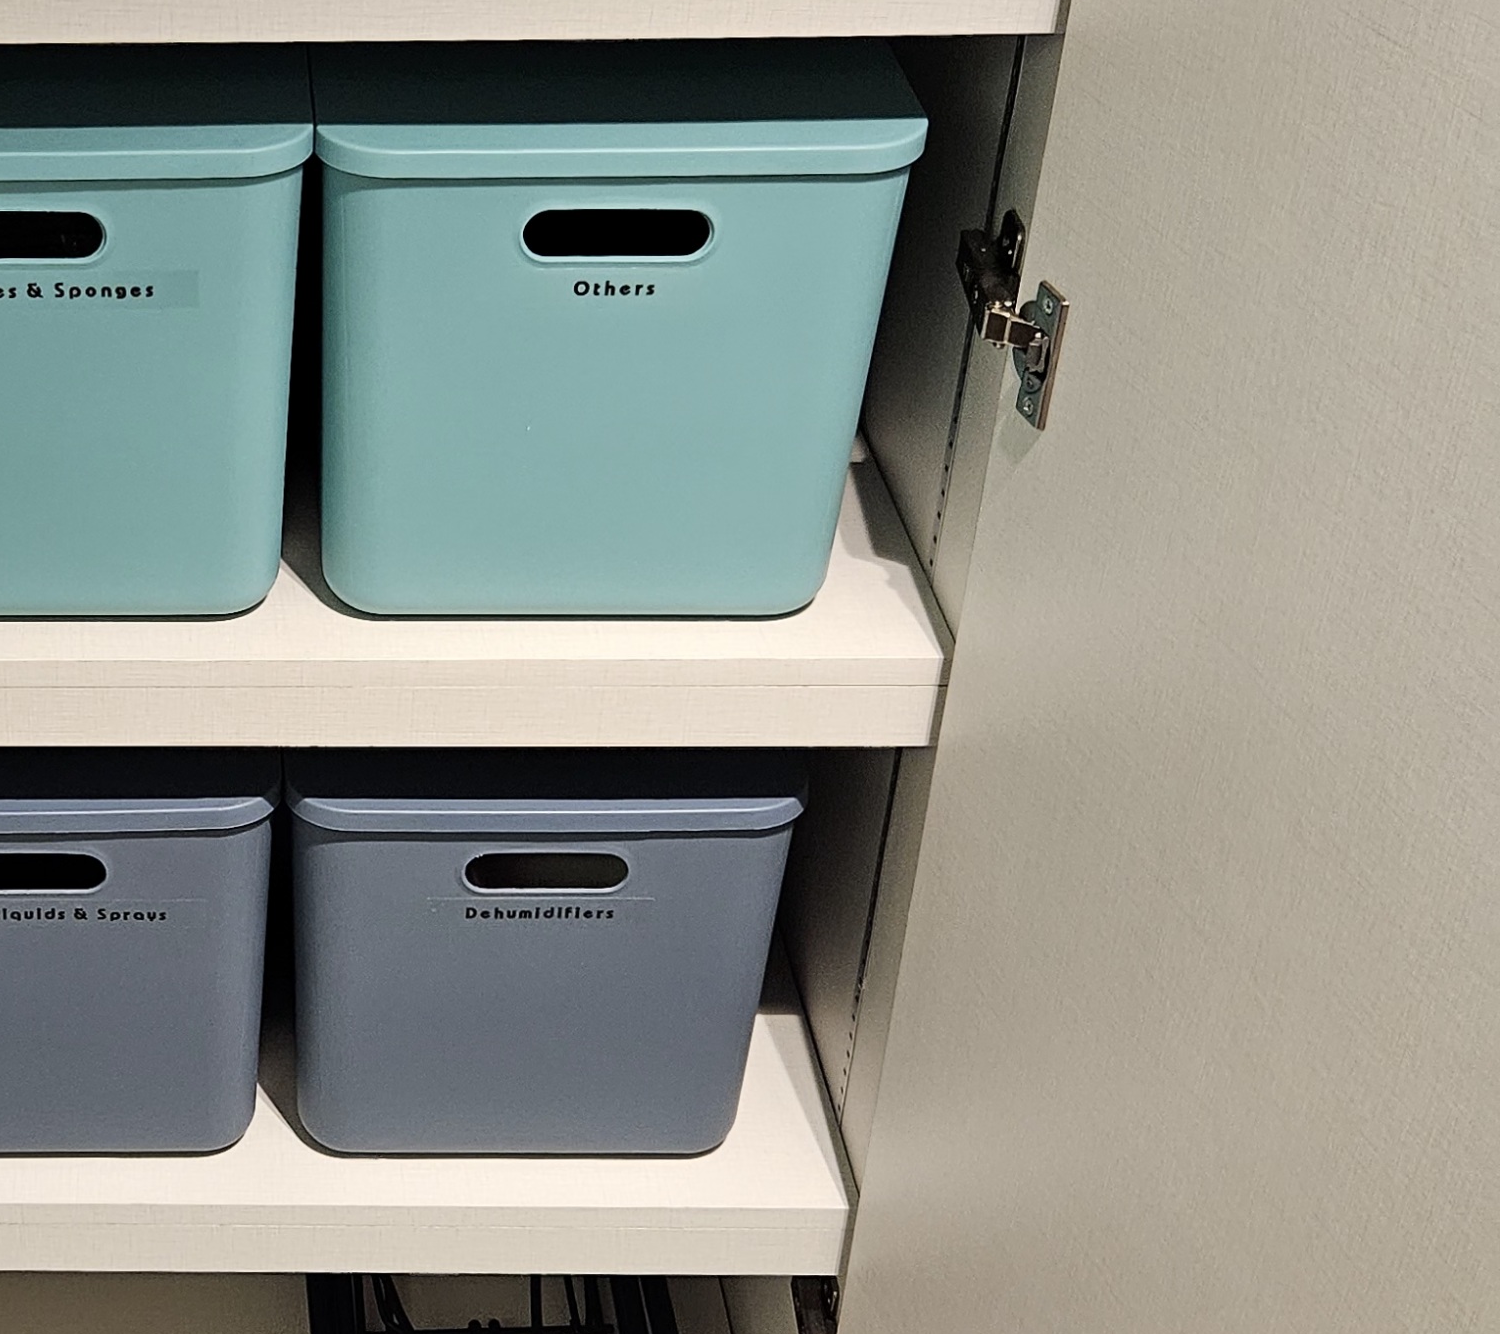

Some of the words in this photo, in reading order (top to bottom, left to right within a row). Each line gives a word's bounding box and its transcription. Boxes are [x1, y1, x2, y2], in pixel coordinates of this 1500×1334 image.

[26, 283, 44, 298] &
[54, 282, 154, 299] Sponges
[573, 280, 655, 296] Others
[74, 908, 88, 920] &
[97, 909, 167, 921] Sprays
[465, 907, 614, 919] Dehumidifiers
